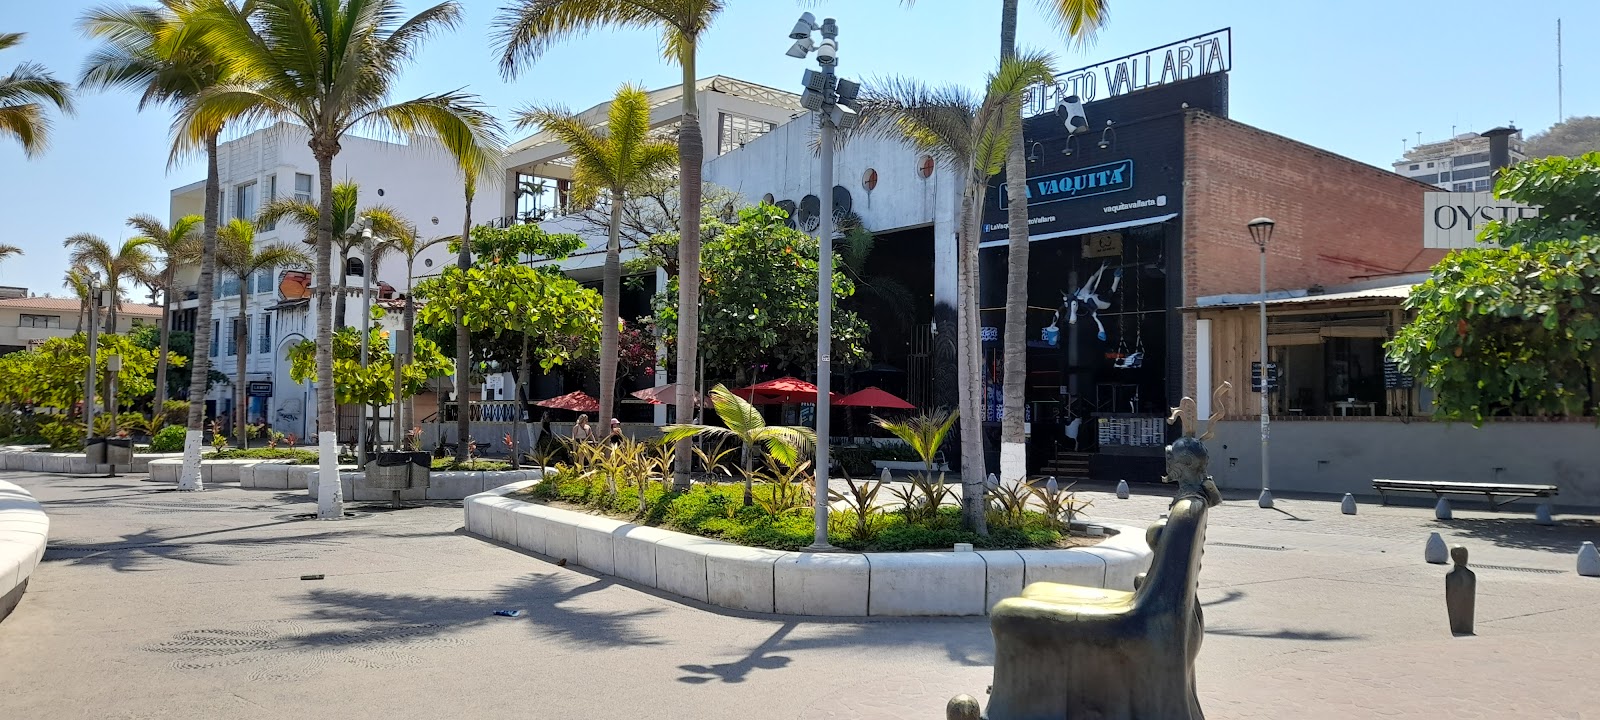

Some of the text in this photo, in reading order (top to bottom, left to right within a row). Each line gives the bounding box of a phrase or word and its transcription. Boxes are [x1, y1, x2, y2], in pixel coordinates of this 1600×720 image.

[1105, 37, 1225, 98] VALLARTA
[1037, 163, 1127, 196] VAQUITA
[1103, 199, 1157, 213] vaquitavallarta
